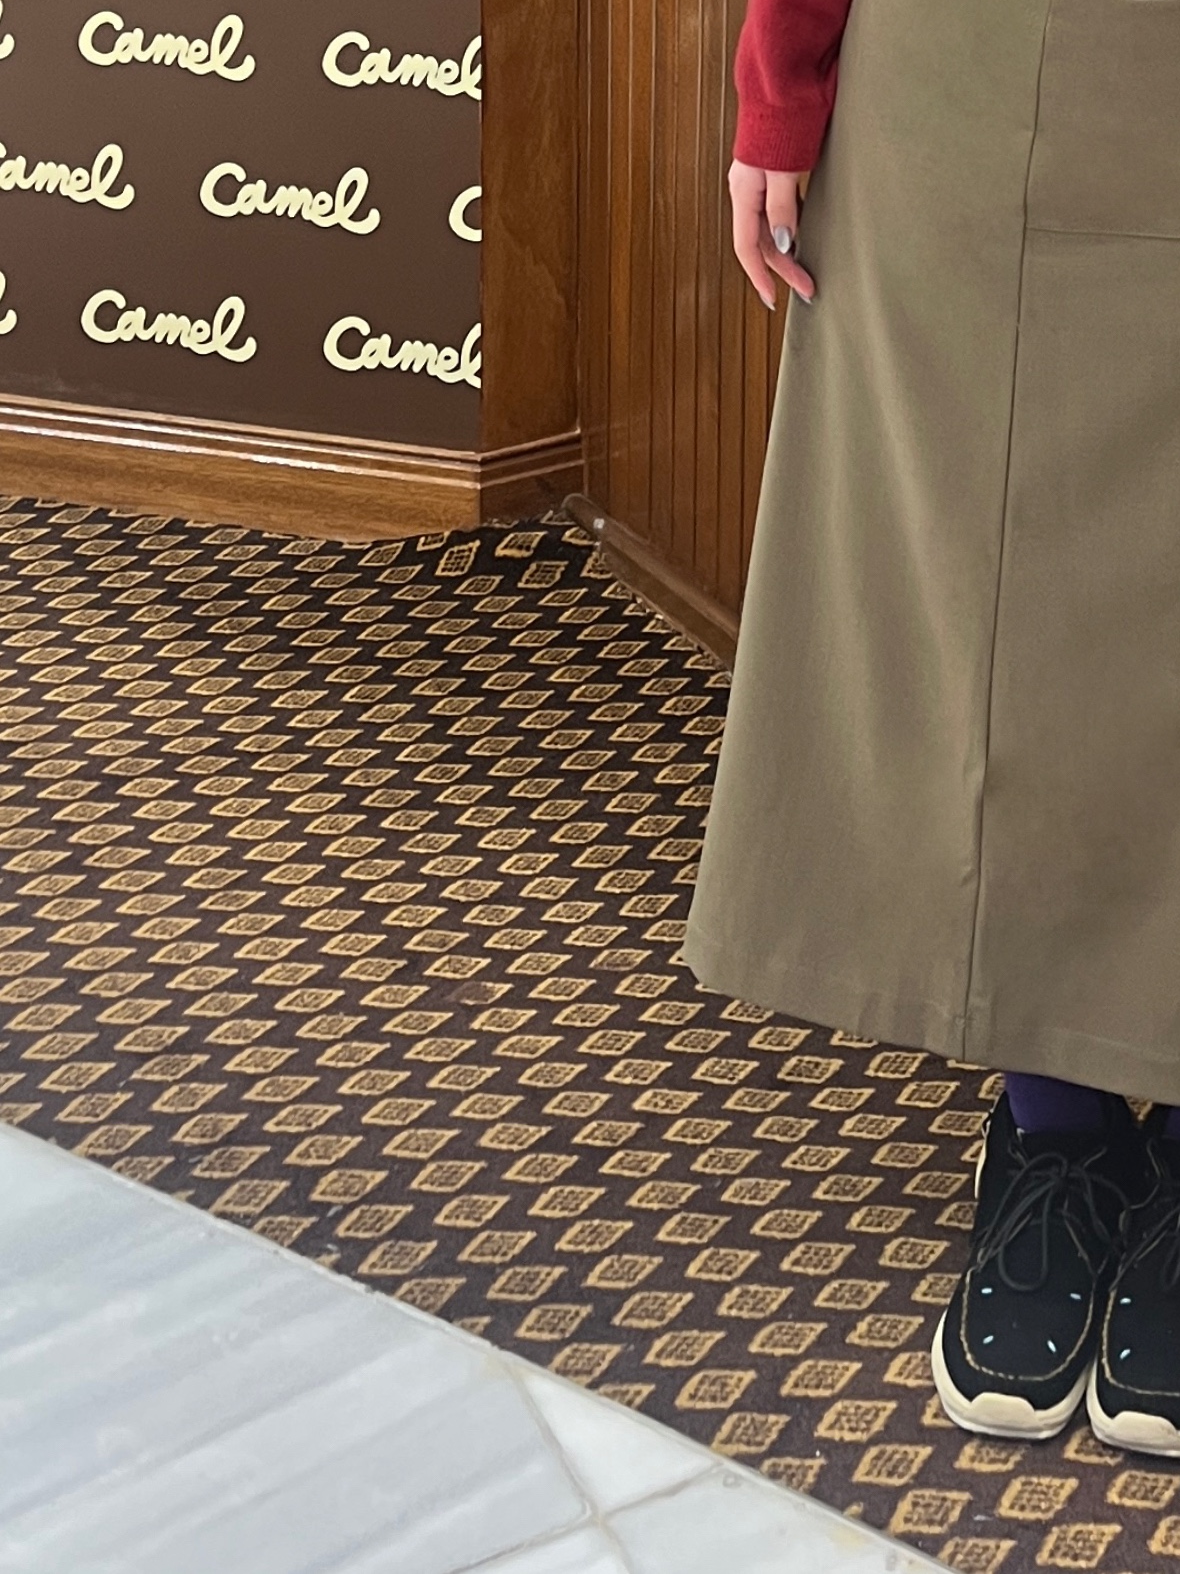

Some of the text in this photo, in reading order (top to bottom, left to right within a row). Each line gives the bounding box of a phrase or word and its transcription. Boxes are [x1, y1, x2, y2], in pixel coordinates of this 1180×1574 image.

[79, 11, 255, 81] Camel
[0, 143, 134, 209] amel
[200, 163, 380, 234] Camel
[81, 290, 256, 362] Camel
